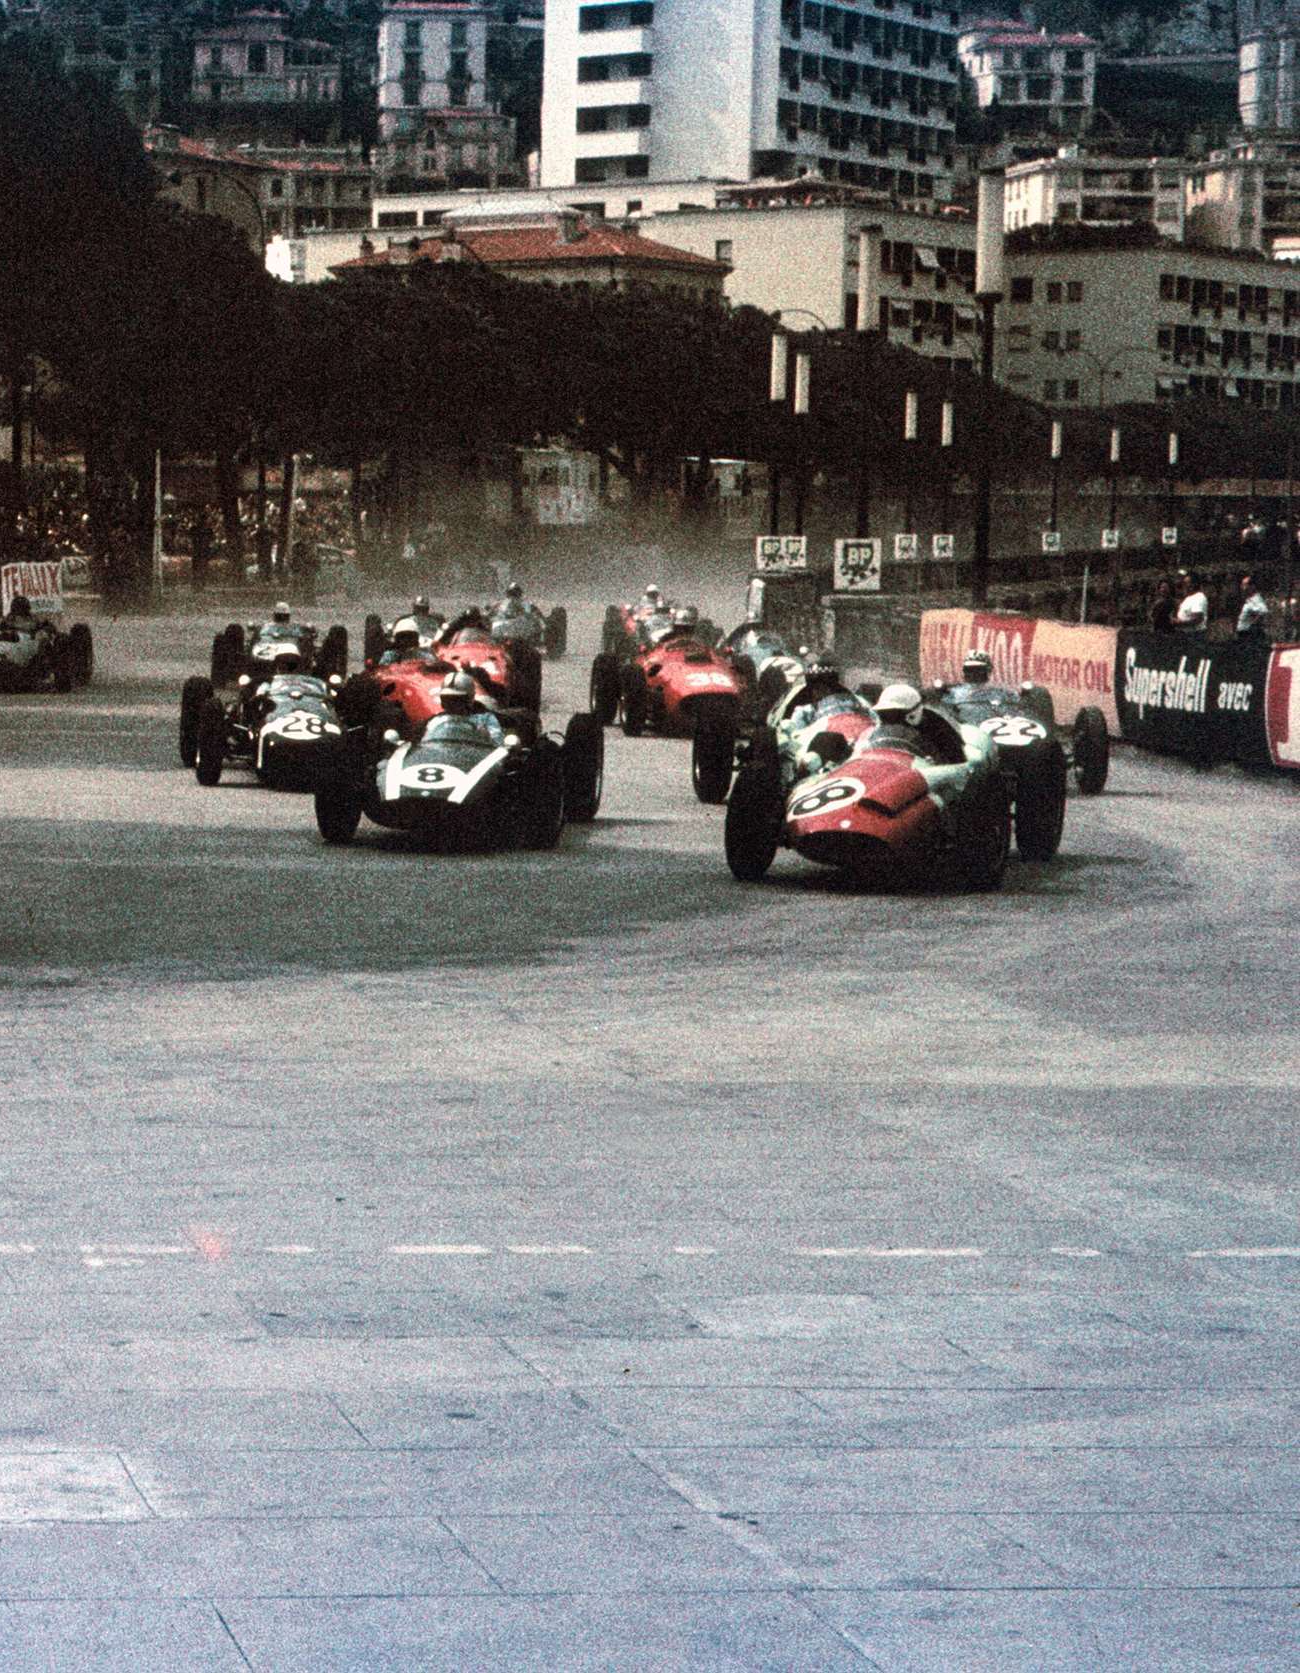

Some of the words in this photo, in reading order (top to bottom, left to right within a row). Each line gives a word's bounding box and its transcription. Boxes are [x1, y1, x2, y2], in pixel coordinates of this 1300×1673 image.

[848, 547, 871, 565] BP
[1084, 658, 1112, 694] OIL
[1124, 646, 1212, 720] Supershell
[1217, 681, 1253, 712] avec
[282, 716, 325, 735] 28
[987, 719, 1044, 738] 22
[417, 766, 445, 783] 8
